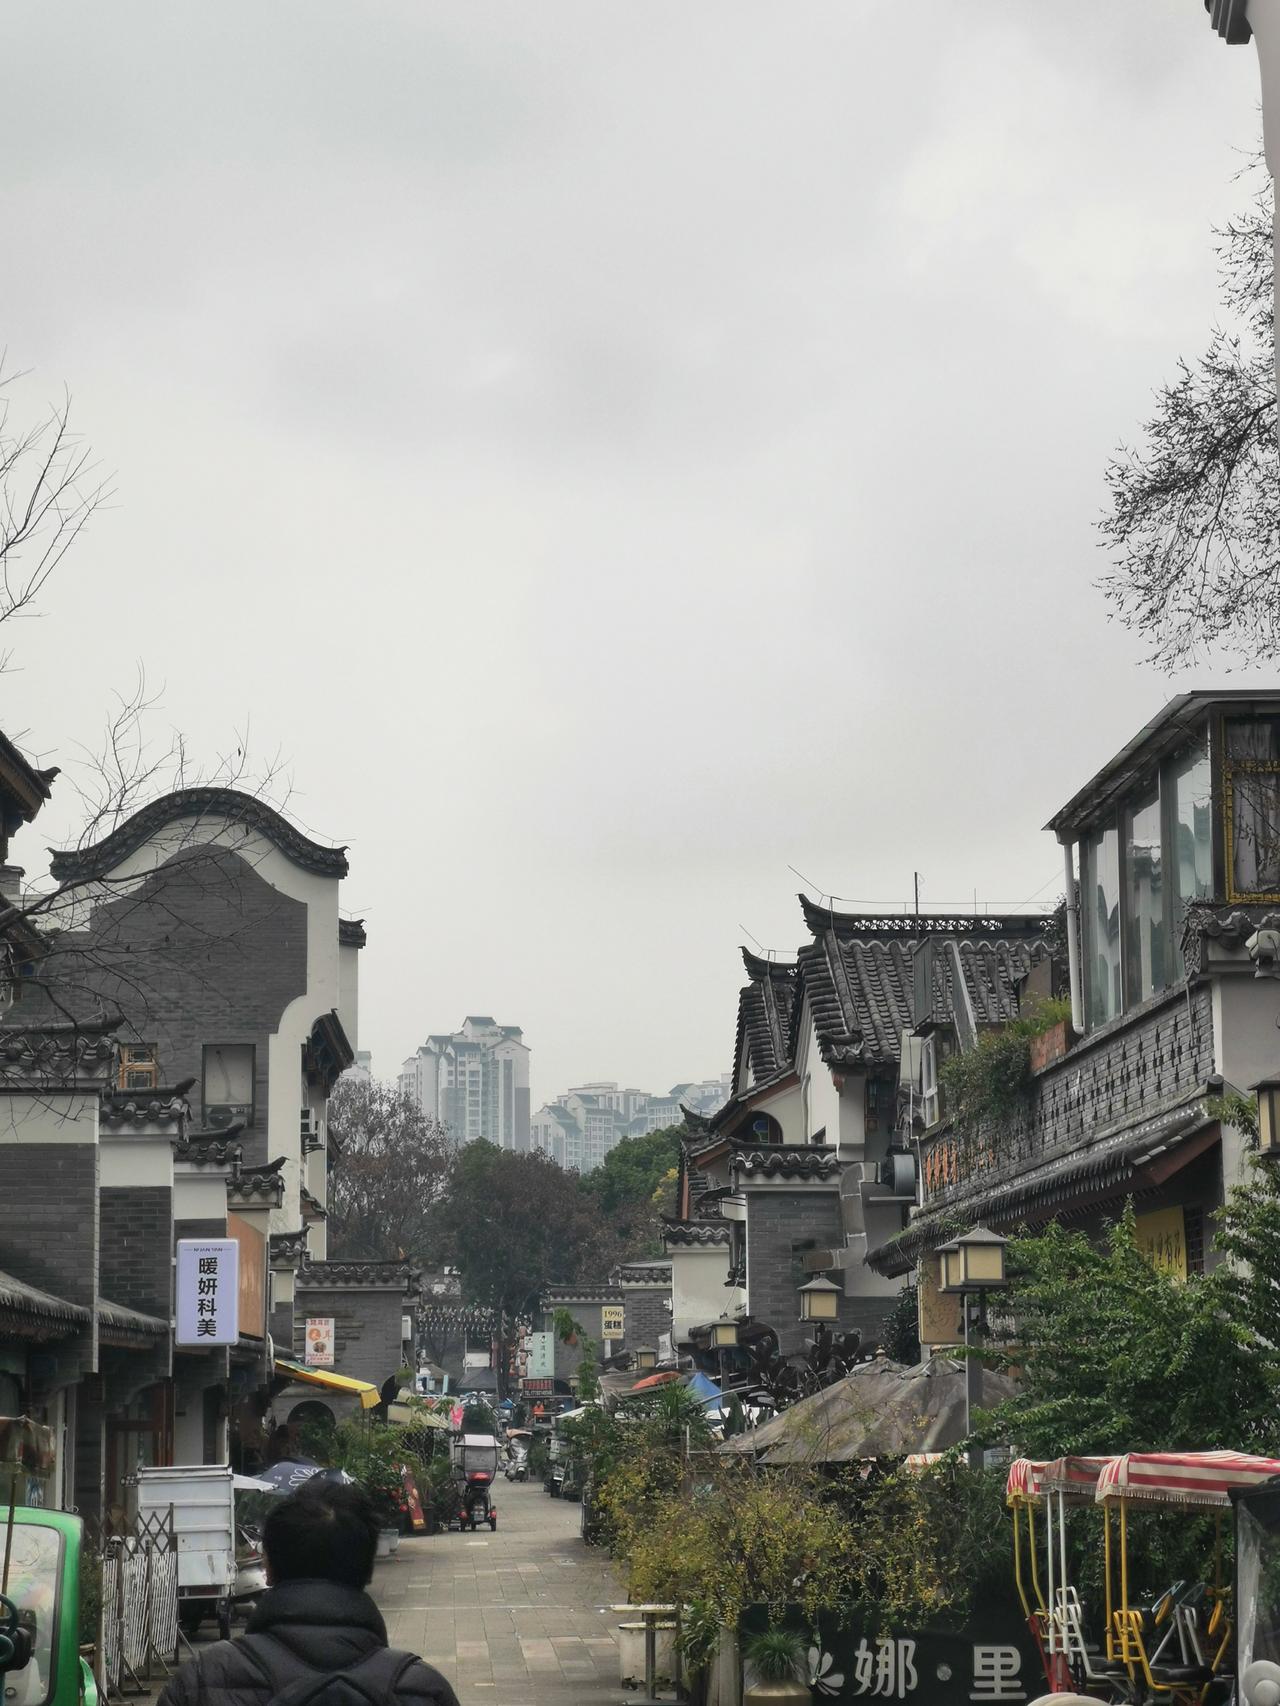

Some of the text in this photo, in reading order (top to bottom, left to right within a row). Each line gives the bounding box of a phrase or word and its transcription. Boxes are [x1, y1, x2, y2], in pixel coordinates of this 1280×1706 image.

[197, 1257, 218, 1337] 暖妍科美
[604, 1310, 622, 1318] 1996
